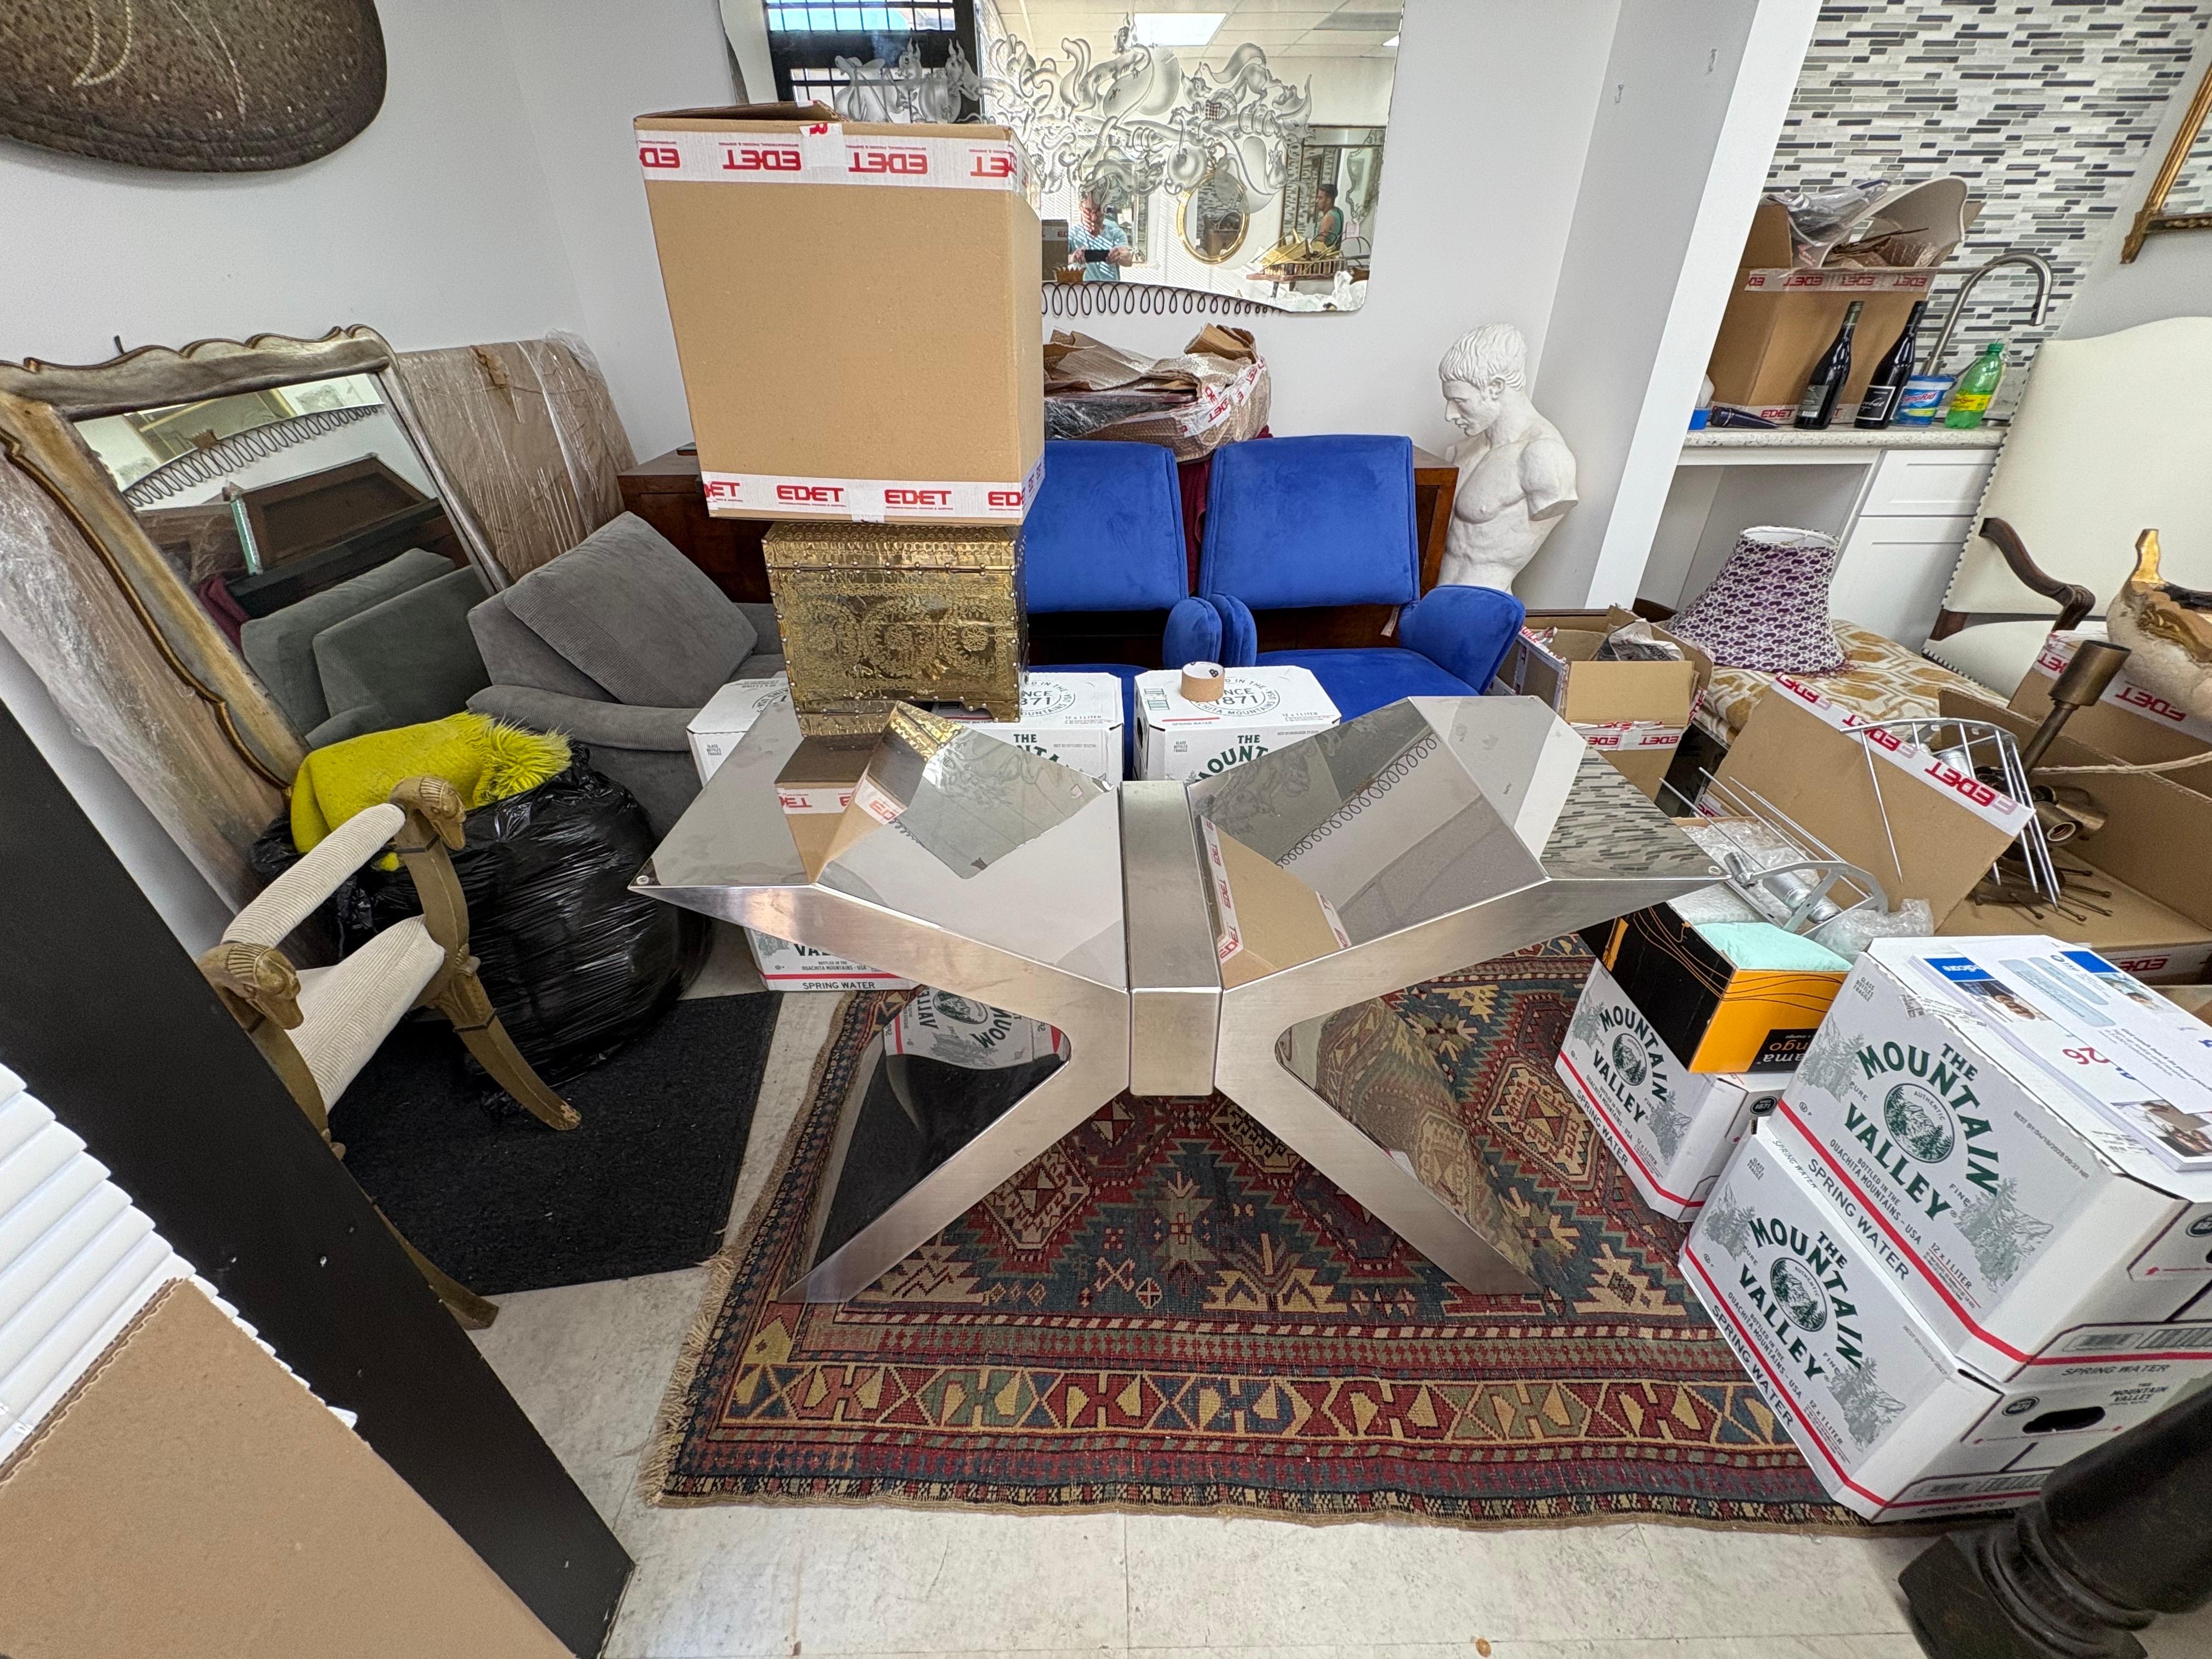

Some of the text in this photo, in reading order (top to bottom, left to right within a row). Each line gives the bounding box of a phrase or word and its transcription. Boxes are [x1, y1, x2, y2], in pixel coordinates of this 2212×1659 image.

[723, 149, 802, 171] EDET
[849, 152, 928, 174] EDET
[777, 484, 844, 502] EDET
[884, 489, 952, 505] EDET
[1224, 688, 1254, 696] NCE
[1020, 703, 1066, 716] OUNTAINS
[1013, 734, 1037, 743] THE
[1238, 734, 1260, 743] THE
[1639, 735, 1680, 746] EDET
[1925, 761, 1997, 808] EDET
[802, 981, 839, 990] SPRING
[1599, 1006, 1668, 1103] MOUNTAIN
[1763, 1053, 1805, 1062] ama
[1769, 1040, 1810, 1051] ngo
[1941, 1042, 1978, 1081] THE
[1593, 1048, 1646, 1124] VALLEY
[1856, 1041, 2000, 1197] MOUNTAIN
[1914, 1091, 1945, 1121] AUTHENTIC
[1576, 1088, 1628, 1166] SPRING WATER
[1773, 1140, 1797, 1166] SPRING
[1830, 1138, 1922, 1245] OUACHITA MOUNTAINS USA
[1857, 1158, 1901, 1206] BOTTLED IN THE
[1808, 1158, 1910, 1280] SPRING WATER
[1816, 1231, 1848, 1270] THE
[1949, 1263, 1973, 1290] LITER
[1748, 1217, 1863, 1371] MOUNTAIN
[1728, 1291, 1802, 1399] OUACHITA MOUNTAINS USA
[1750, 1313, 1769, 1341] BOTTLED
[1774, 1346, 1785, 1362] THE
[1712, 1305, 1793, 1427] SPRING WATER
[2061, 1364, 2170, 1376] SPRING WATER
